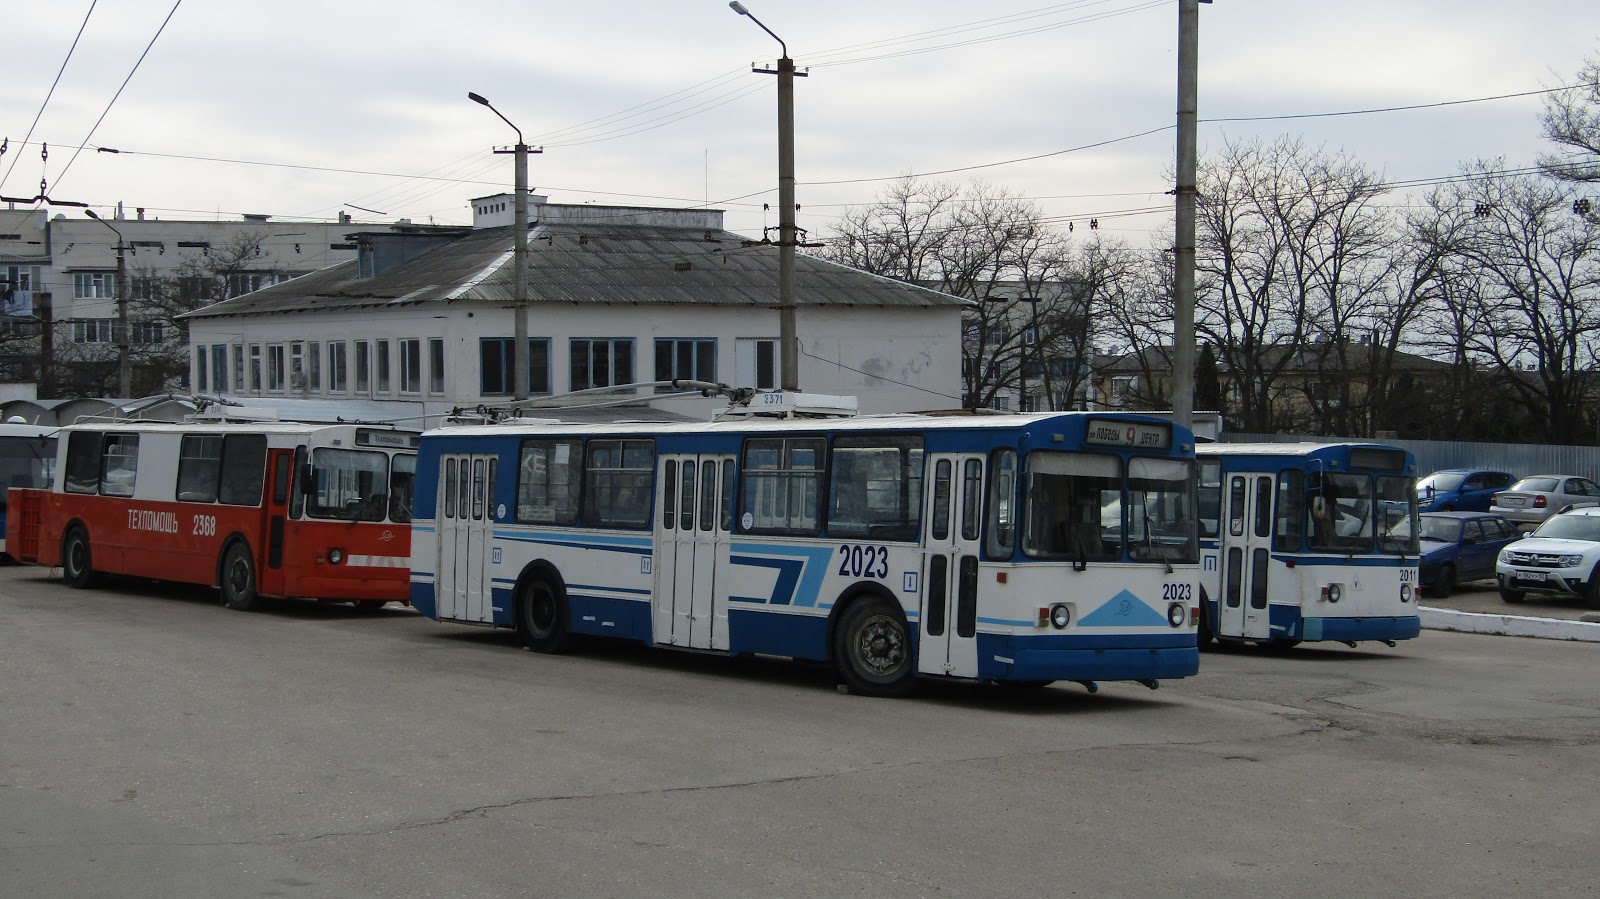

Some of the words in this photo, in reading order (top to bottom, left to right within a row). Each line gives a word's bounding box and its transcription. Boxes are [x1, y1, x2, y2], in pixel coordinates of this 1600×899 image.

[764, 394, 783, 404] 2371
[1126, 426, 1136, 446] 9
[128, 509, 179, 534] ТЕХПОМОЩЬ
[193, 514, 216, 537] 2368
[838, 544, 889, 579] 2023
[1400, 569, 1416, 581] 2011
[1162, 583, 1191, 600] 2023
